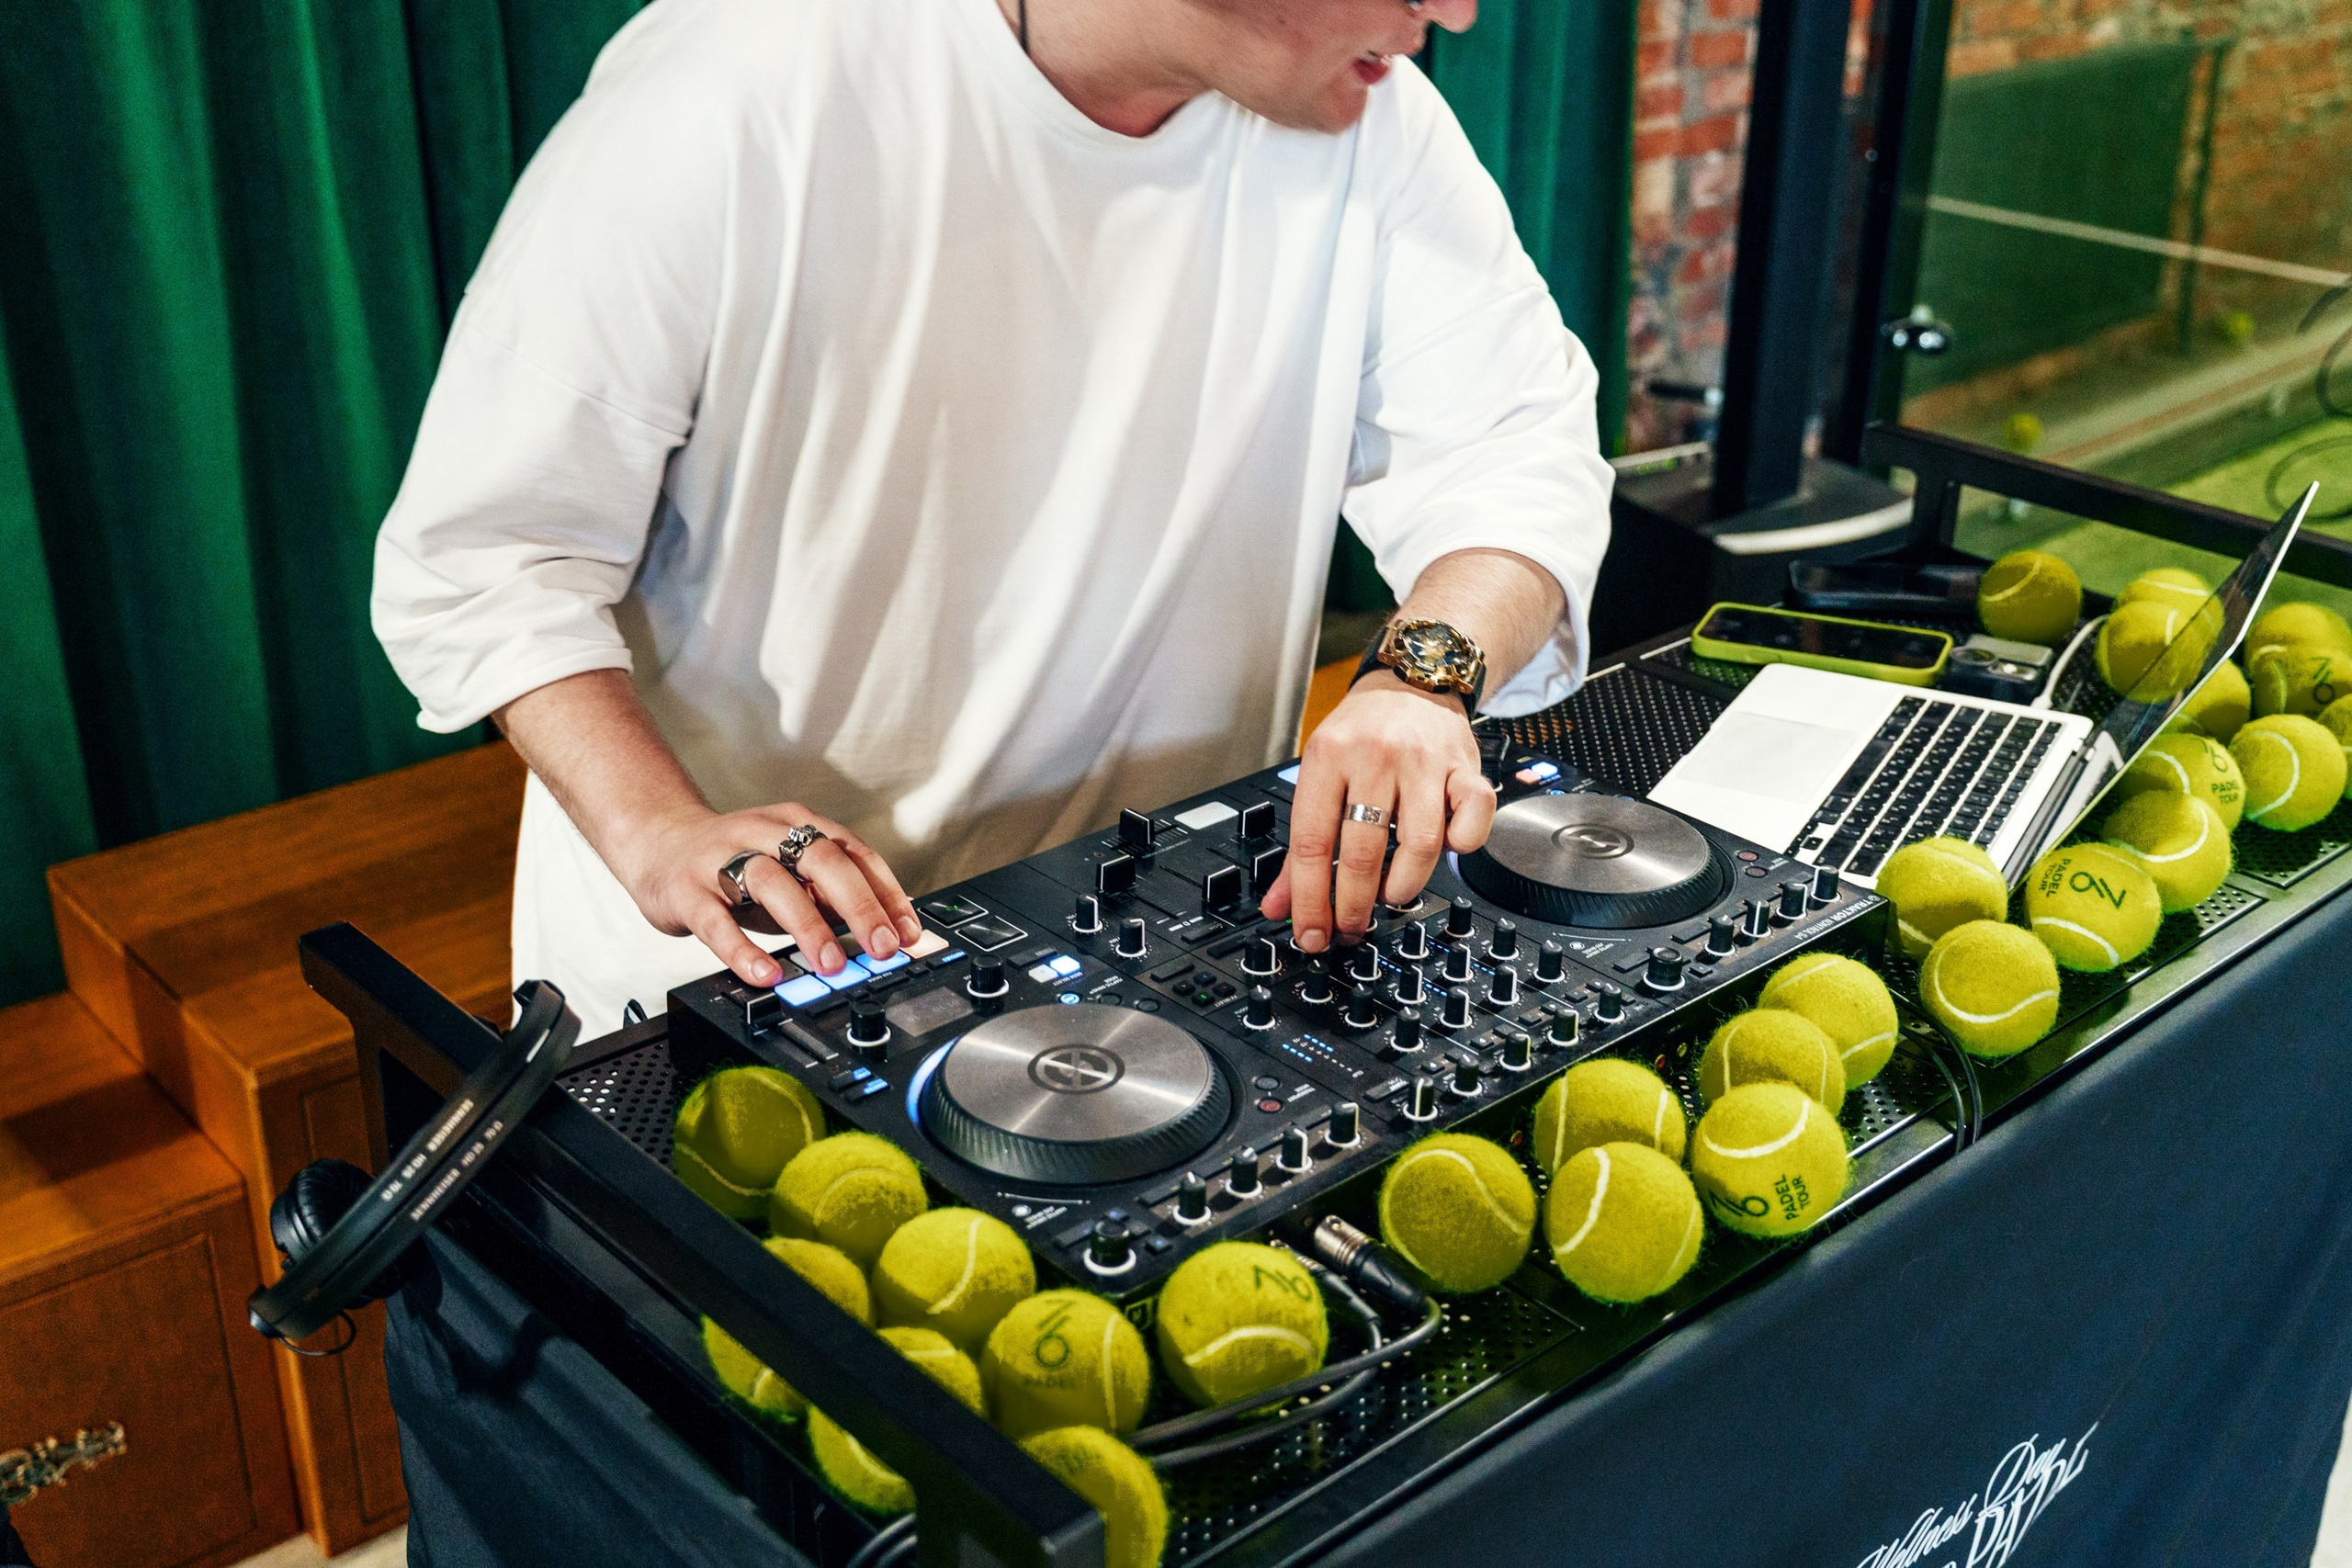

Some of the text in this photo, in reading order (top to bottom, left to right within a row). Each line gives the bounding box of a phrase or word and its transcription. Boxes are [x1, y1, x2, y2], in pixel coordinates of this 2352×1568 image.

[2046, 858, 2072, 898] PADEL
[1829, 898, 1873, 922] TRAKTOR
[410, 1168, 460, 1222] SENNHEISER
[1773, 1174, 1800, 1221] PADEL
[1791, 1175, 1810, 1210] TOUR
